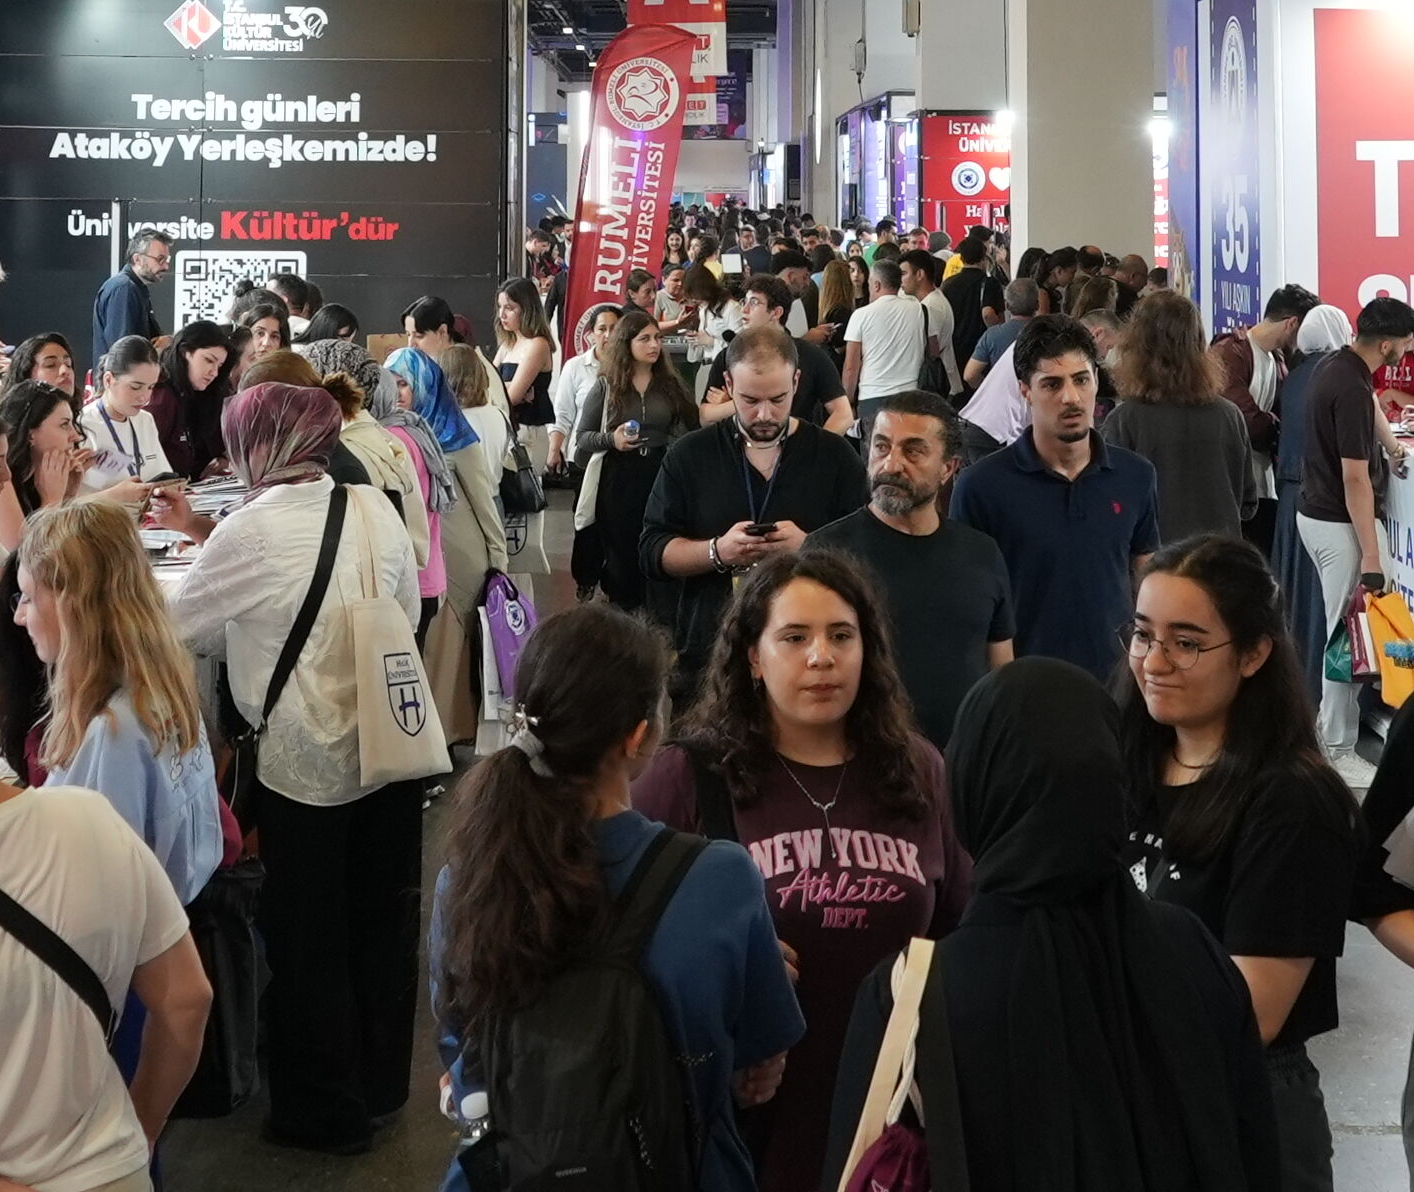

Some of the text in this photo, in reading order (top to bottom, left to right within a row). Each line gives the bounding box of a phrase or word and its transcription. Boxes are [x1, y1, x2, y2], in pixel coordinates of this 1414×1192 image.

[222, 38, 304, 52] ÜNİVERSİTESİ
[131, 91, 361, 131] Tercih günleri
[49, 131, 438, 168] Ataköy Yerleşkemizde!
[220, 210, 399, 242] Kültür'dür
[1220, 174, 1250, 274] 35
[748, 826, 927, 886] NEW YORK
[777, 868, 907, 913] Athletic
[820, 906, 870, 930] DEPT.
